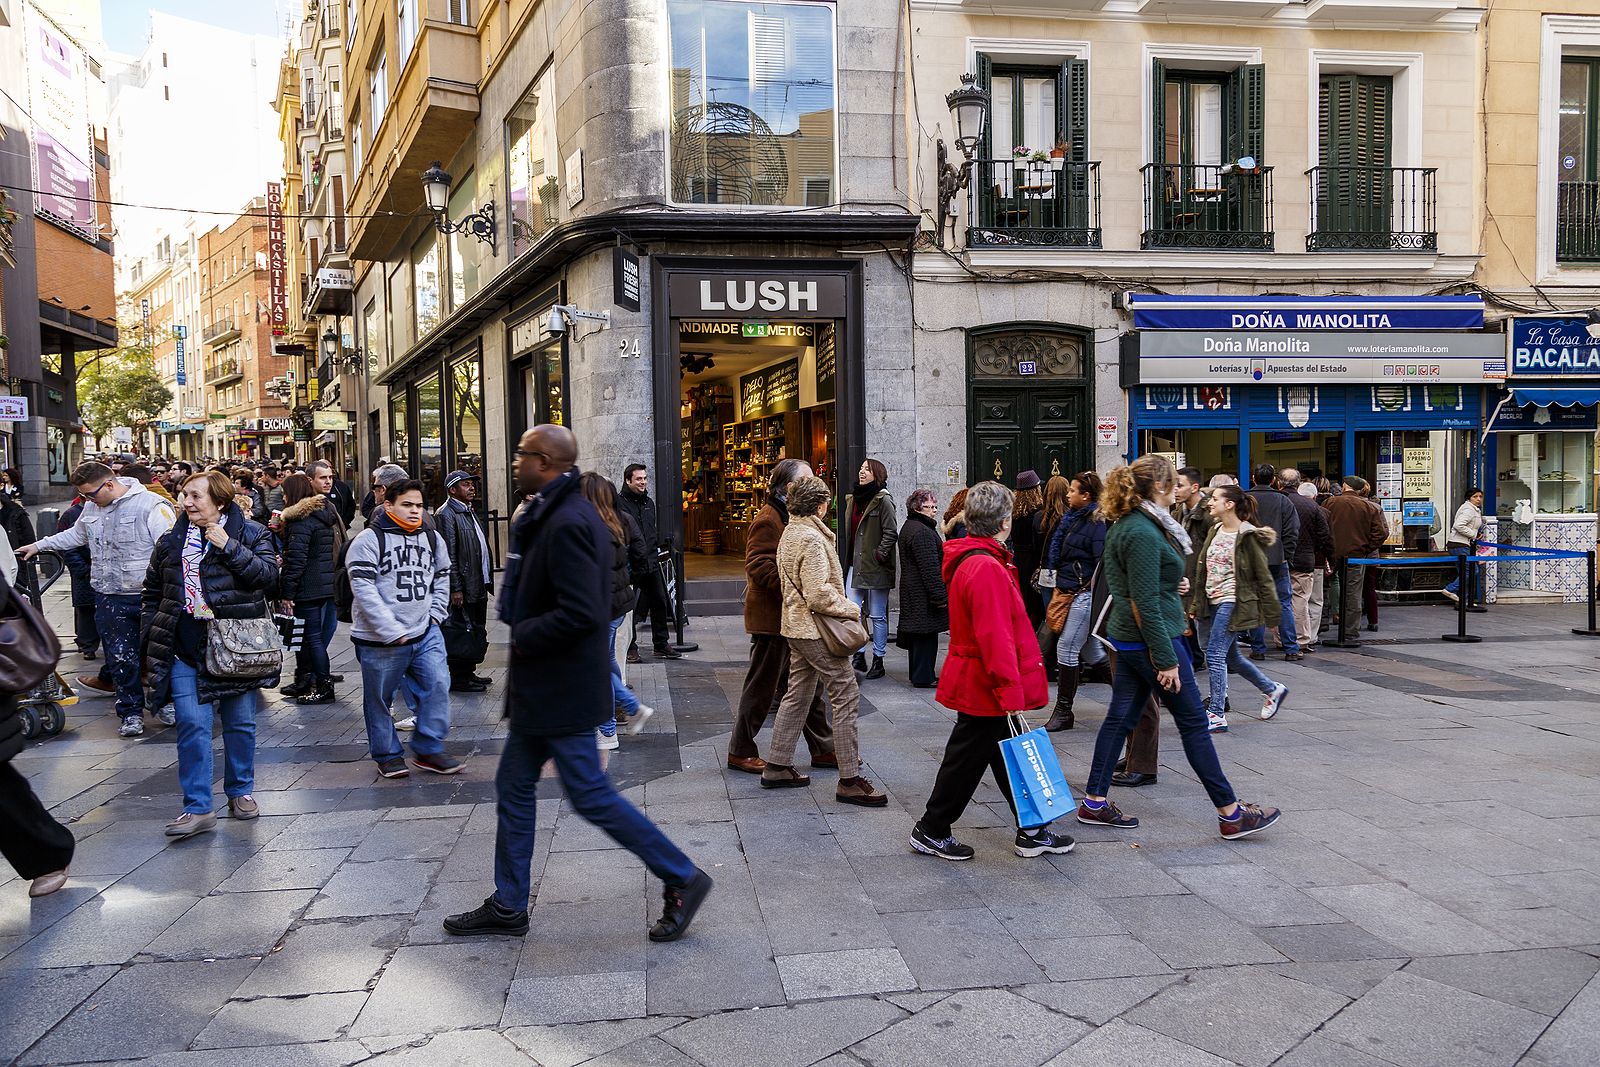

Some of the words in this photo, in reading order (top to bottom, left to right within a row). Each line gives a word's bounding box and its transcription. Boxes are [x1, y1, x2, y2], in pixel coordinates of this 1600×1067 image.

[268, 185, 280, 228] HOTEL
[624, 258, 638, 276] LUSH
[272, 243, 284, 322] CASTILLAS
[700, 280, 818, 311] LUSH
[1232, 310, 1286, 328] DOÑA
[1297, 314, 1392, 328] MANOLITA
[1204, 338, 1242, 352] Doña
[1246, 338, 1310, 352] Manolita
[1524, 328, 1544, 345] La
[1548, 328, 1580, 345] Casa
[620, 338, 640, 358] 24
[1516, 348, 1600, 367] BACALA
[1022, 363, 1033, 372] 22
[1209, 364, 1242, 372] Loterías
[1267, 364, 1304, 373] Apuestas
[1306, 364, 1318, 372] del
[1320, 364, 1347, 373] Estado
[396, 571, 427, 602] 58
[1022, 740, 1053, 798] Sabadell
